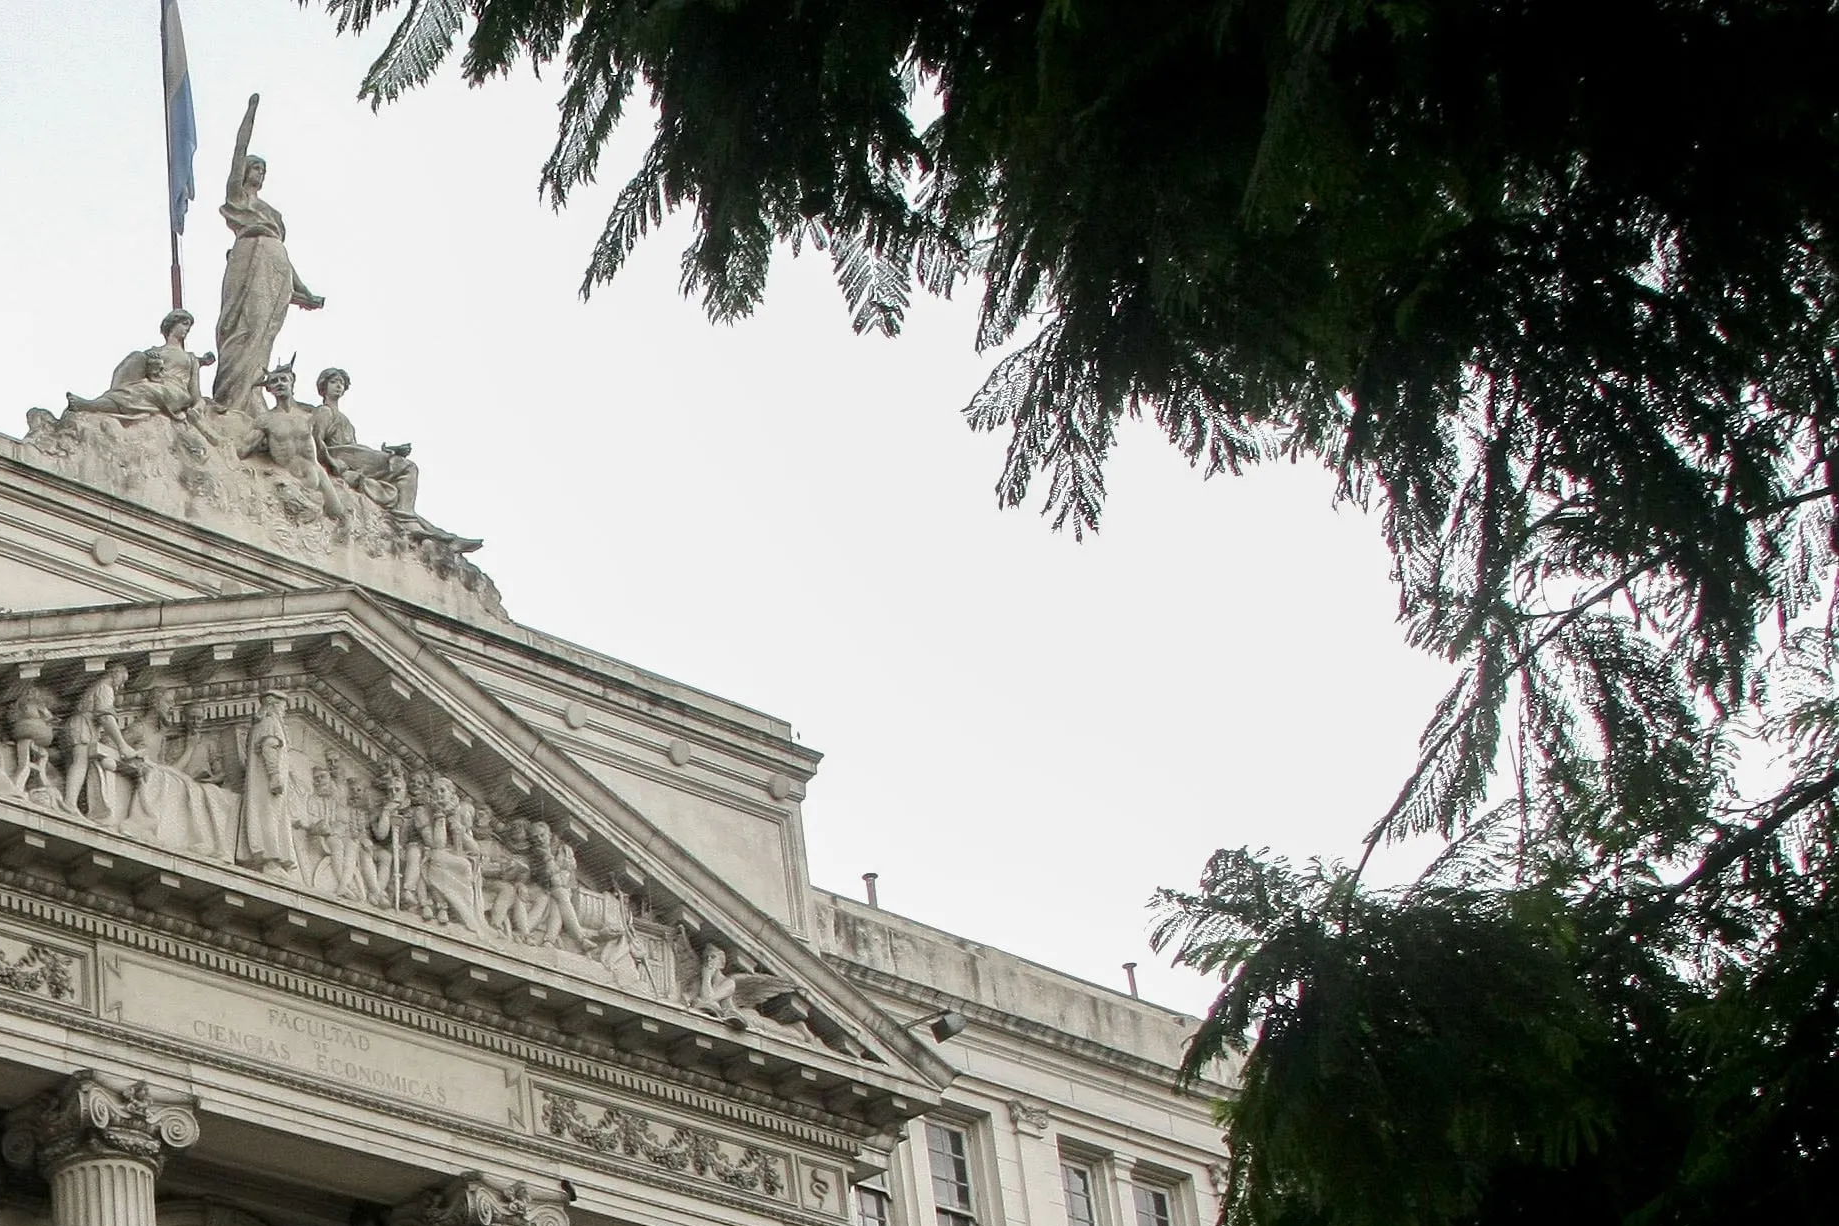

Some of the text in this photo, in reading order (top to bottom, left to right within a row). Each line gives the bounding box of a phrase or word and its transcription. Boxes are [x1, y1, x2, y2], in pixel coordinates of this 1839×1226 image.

[267, 1008, 371, 1052] FACULTAD
[313, 1040, 329, 1053] DE
[192, 1019, 447, 1104] CIENCIAS ECONOMICAS
